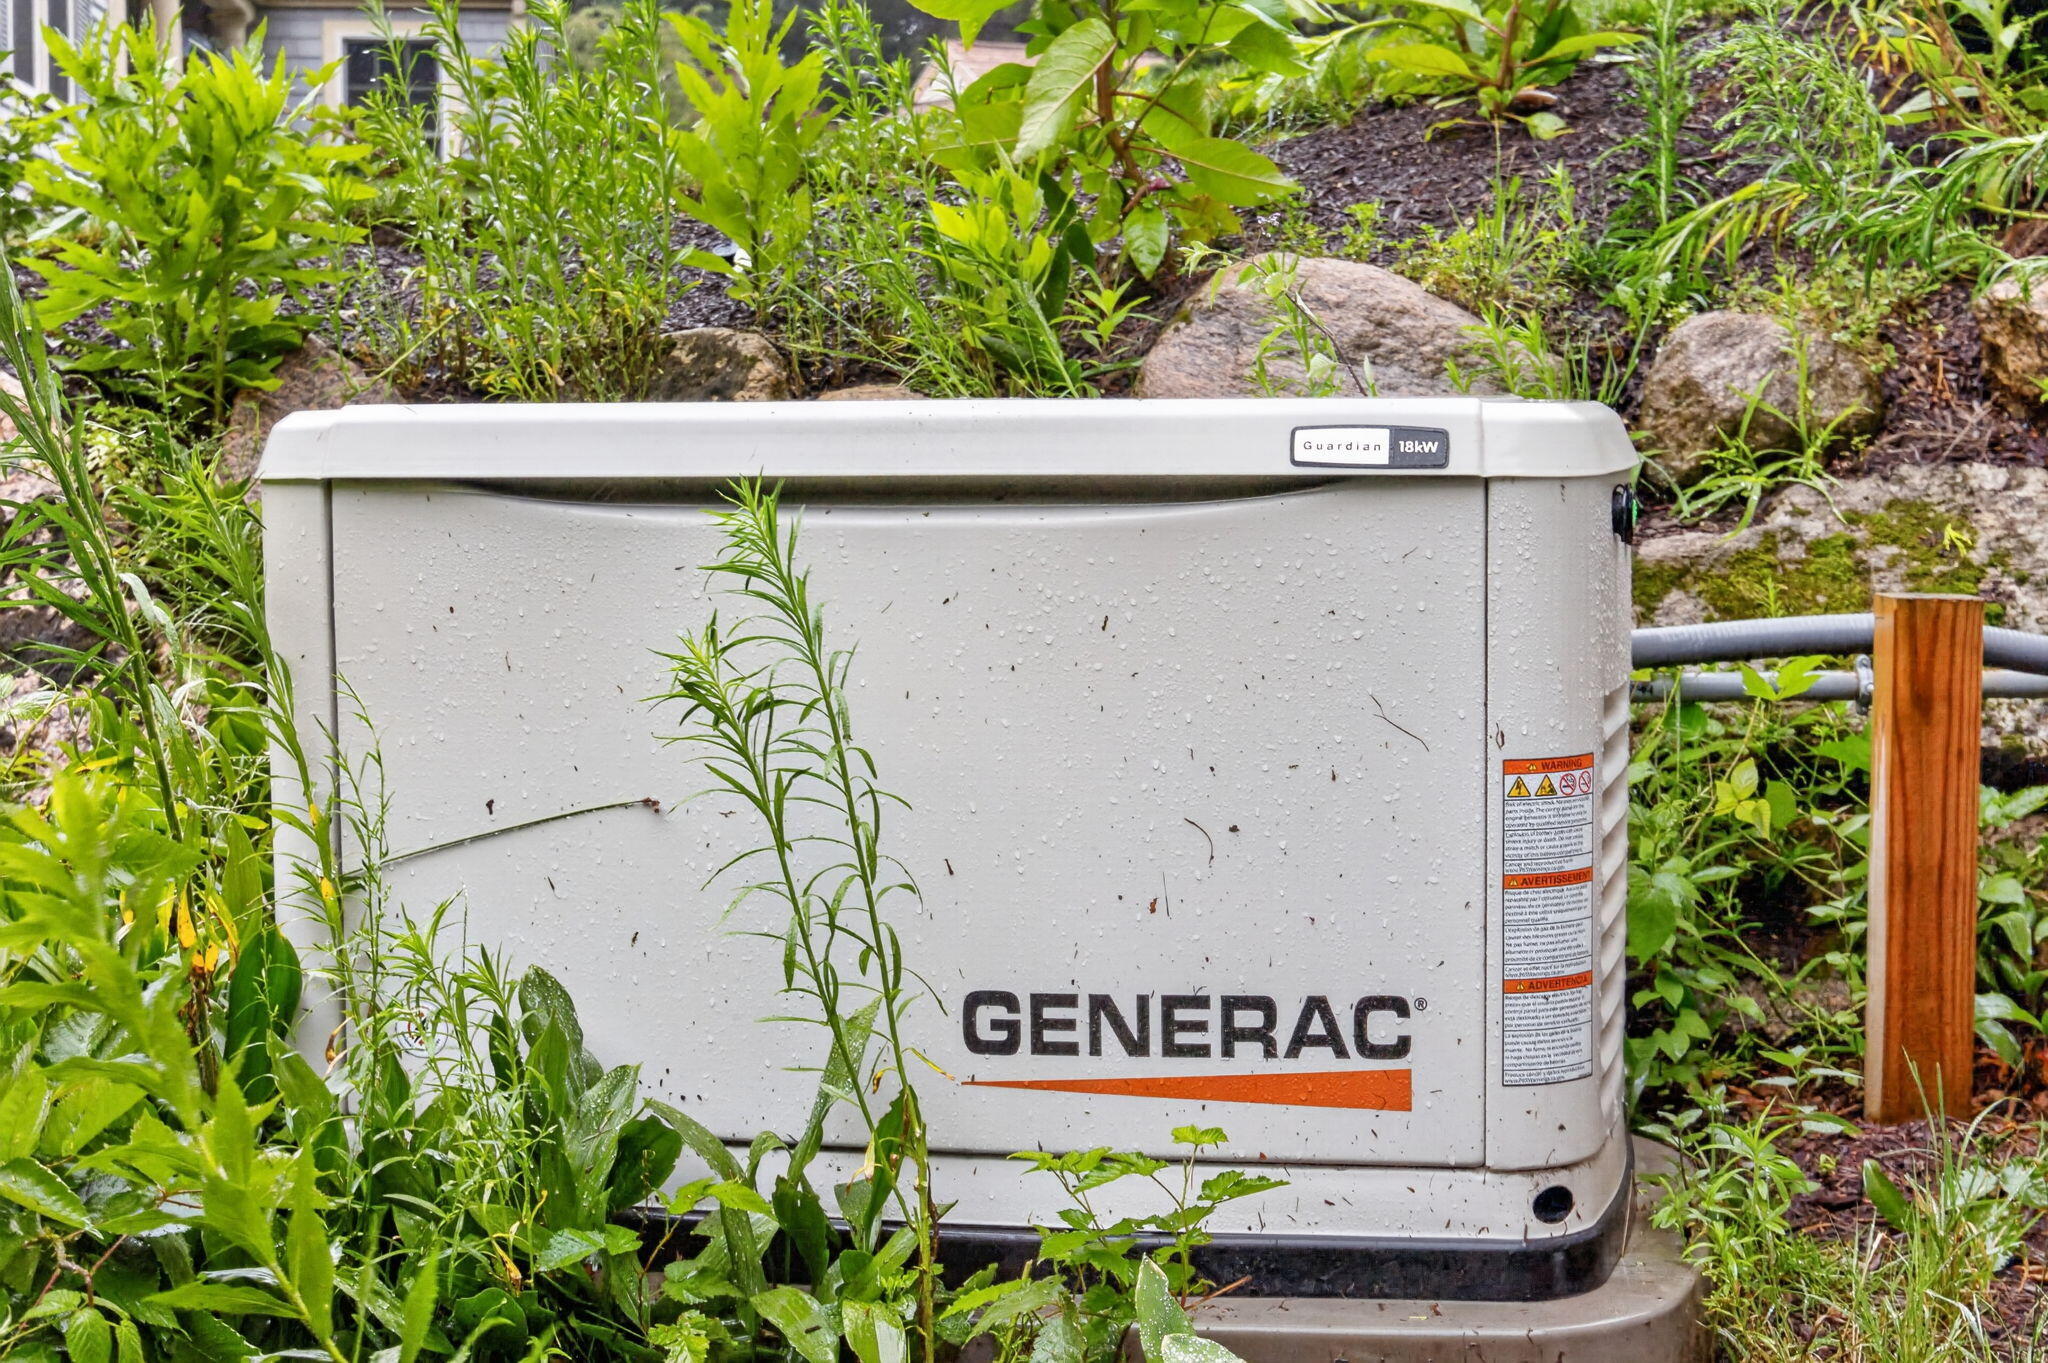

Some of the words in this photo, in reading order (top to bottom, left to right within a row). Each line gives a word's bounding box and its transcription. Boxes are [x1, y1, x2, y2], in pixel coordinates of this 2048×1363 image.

[1303, 441, 1381, 451] Guardian
[1398, 440, 1439, 453] 18kW
[1541, 758, 1582, 770] WARNING
[1520, 870, 1590, 886] AVERTISSEMENT
[1528, 976, 1587, 990] ADVERTENCIA
[962, 990, 1412, 1060] GENERAC
